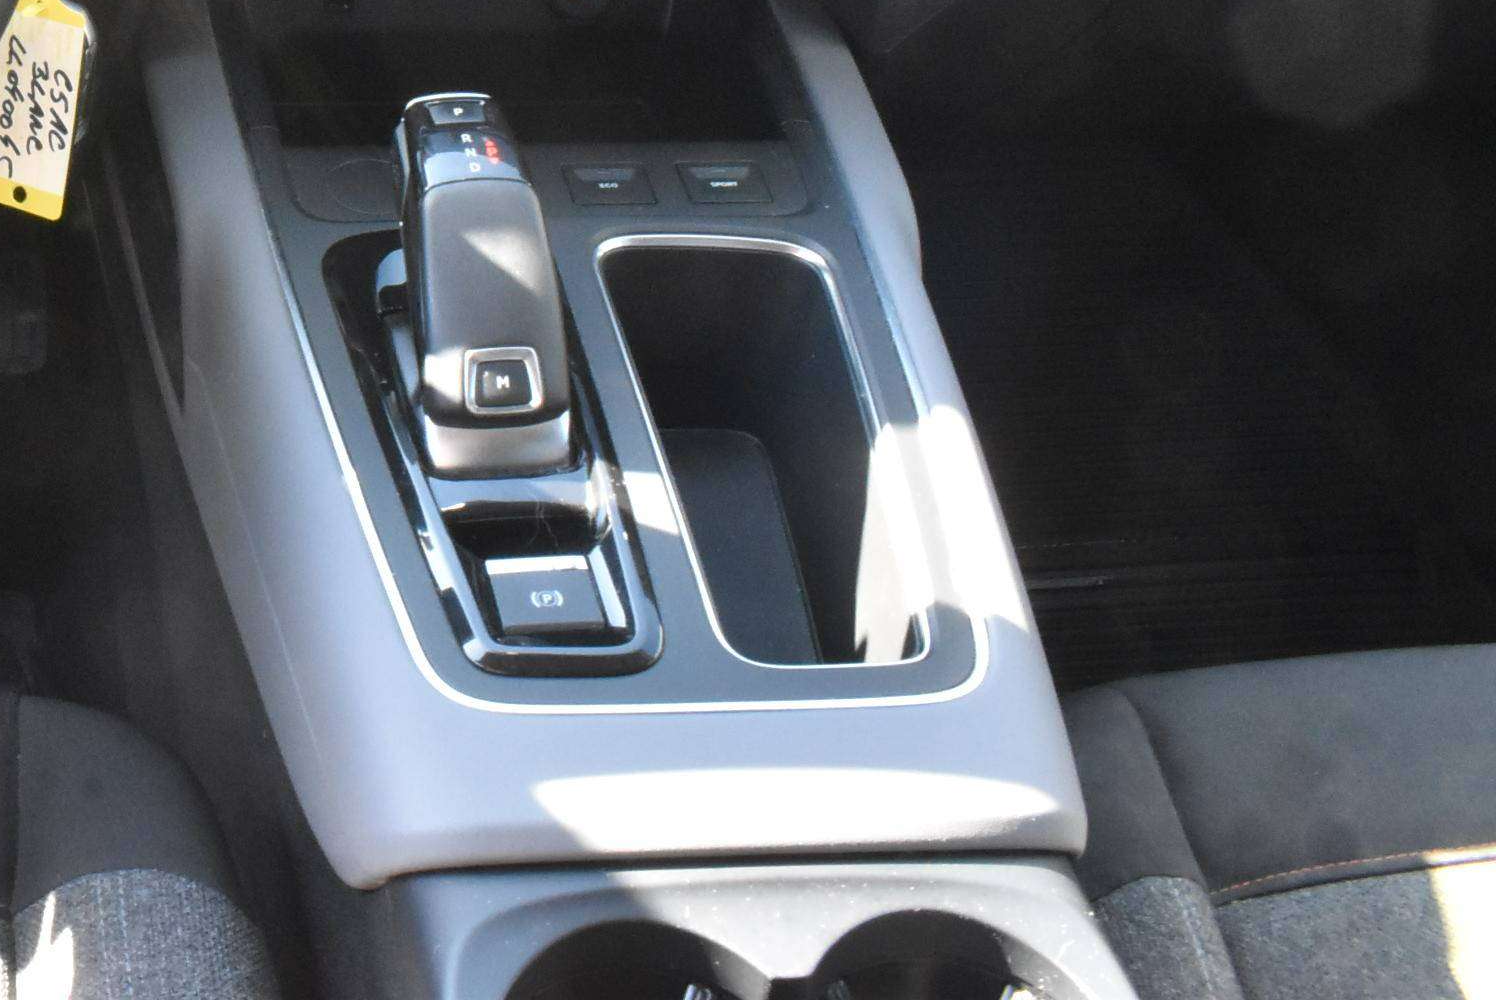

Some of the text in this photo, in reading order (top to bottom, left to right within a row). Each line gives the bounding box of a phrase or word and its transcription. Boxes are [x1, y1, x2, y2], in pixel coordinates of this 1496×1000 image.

[453, 107, 464, 117] P
[460, 133, 472, 143] R
[464, 147, 477, 158] N
